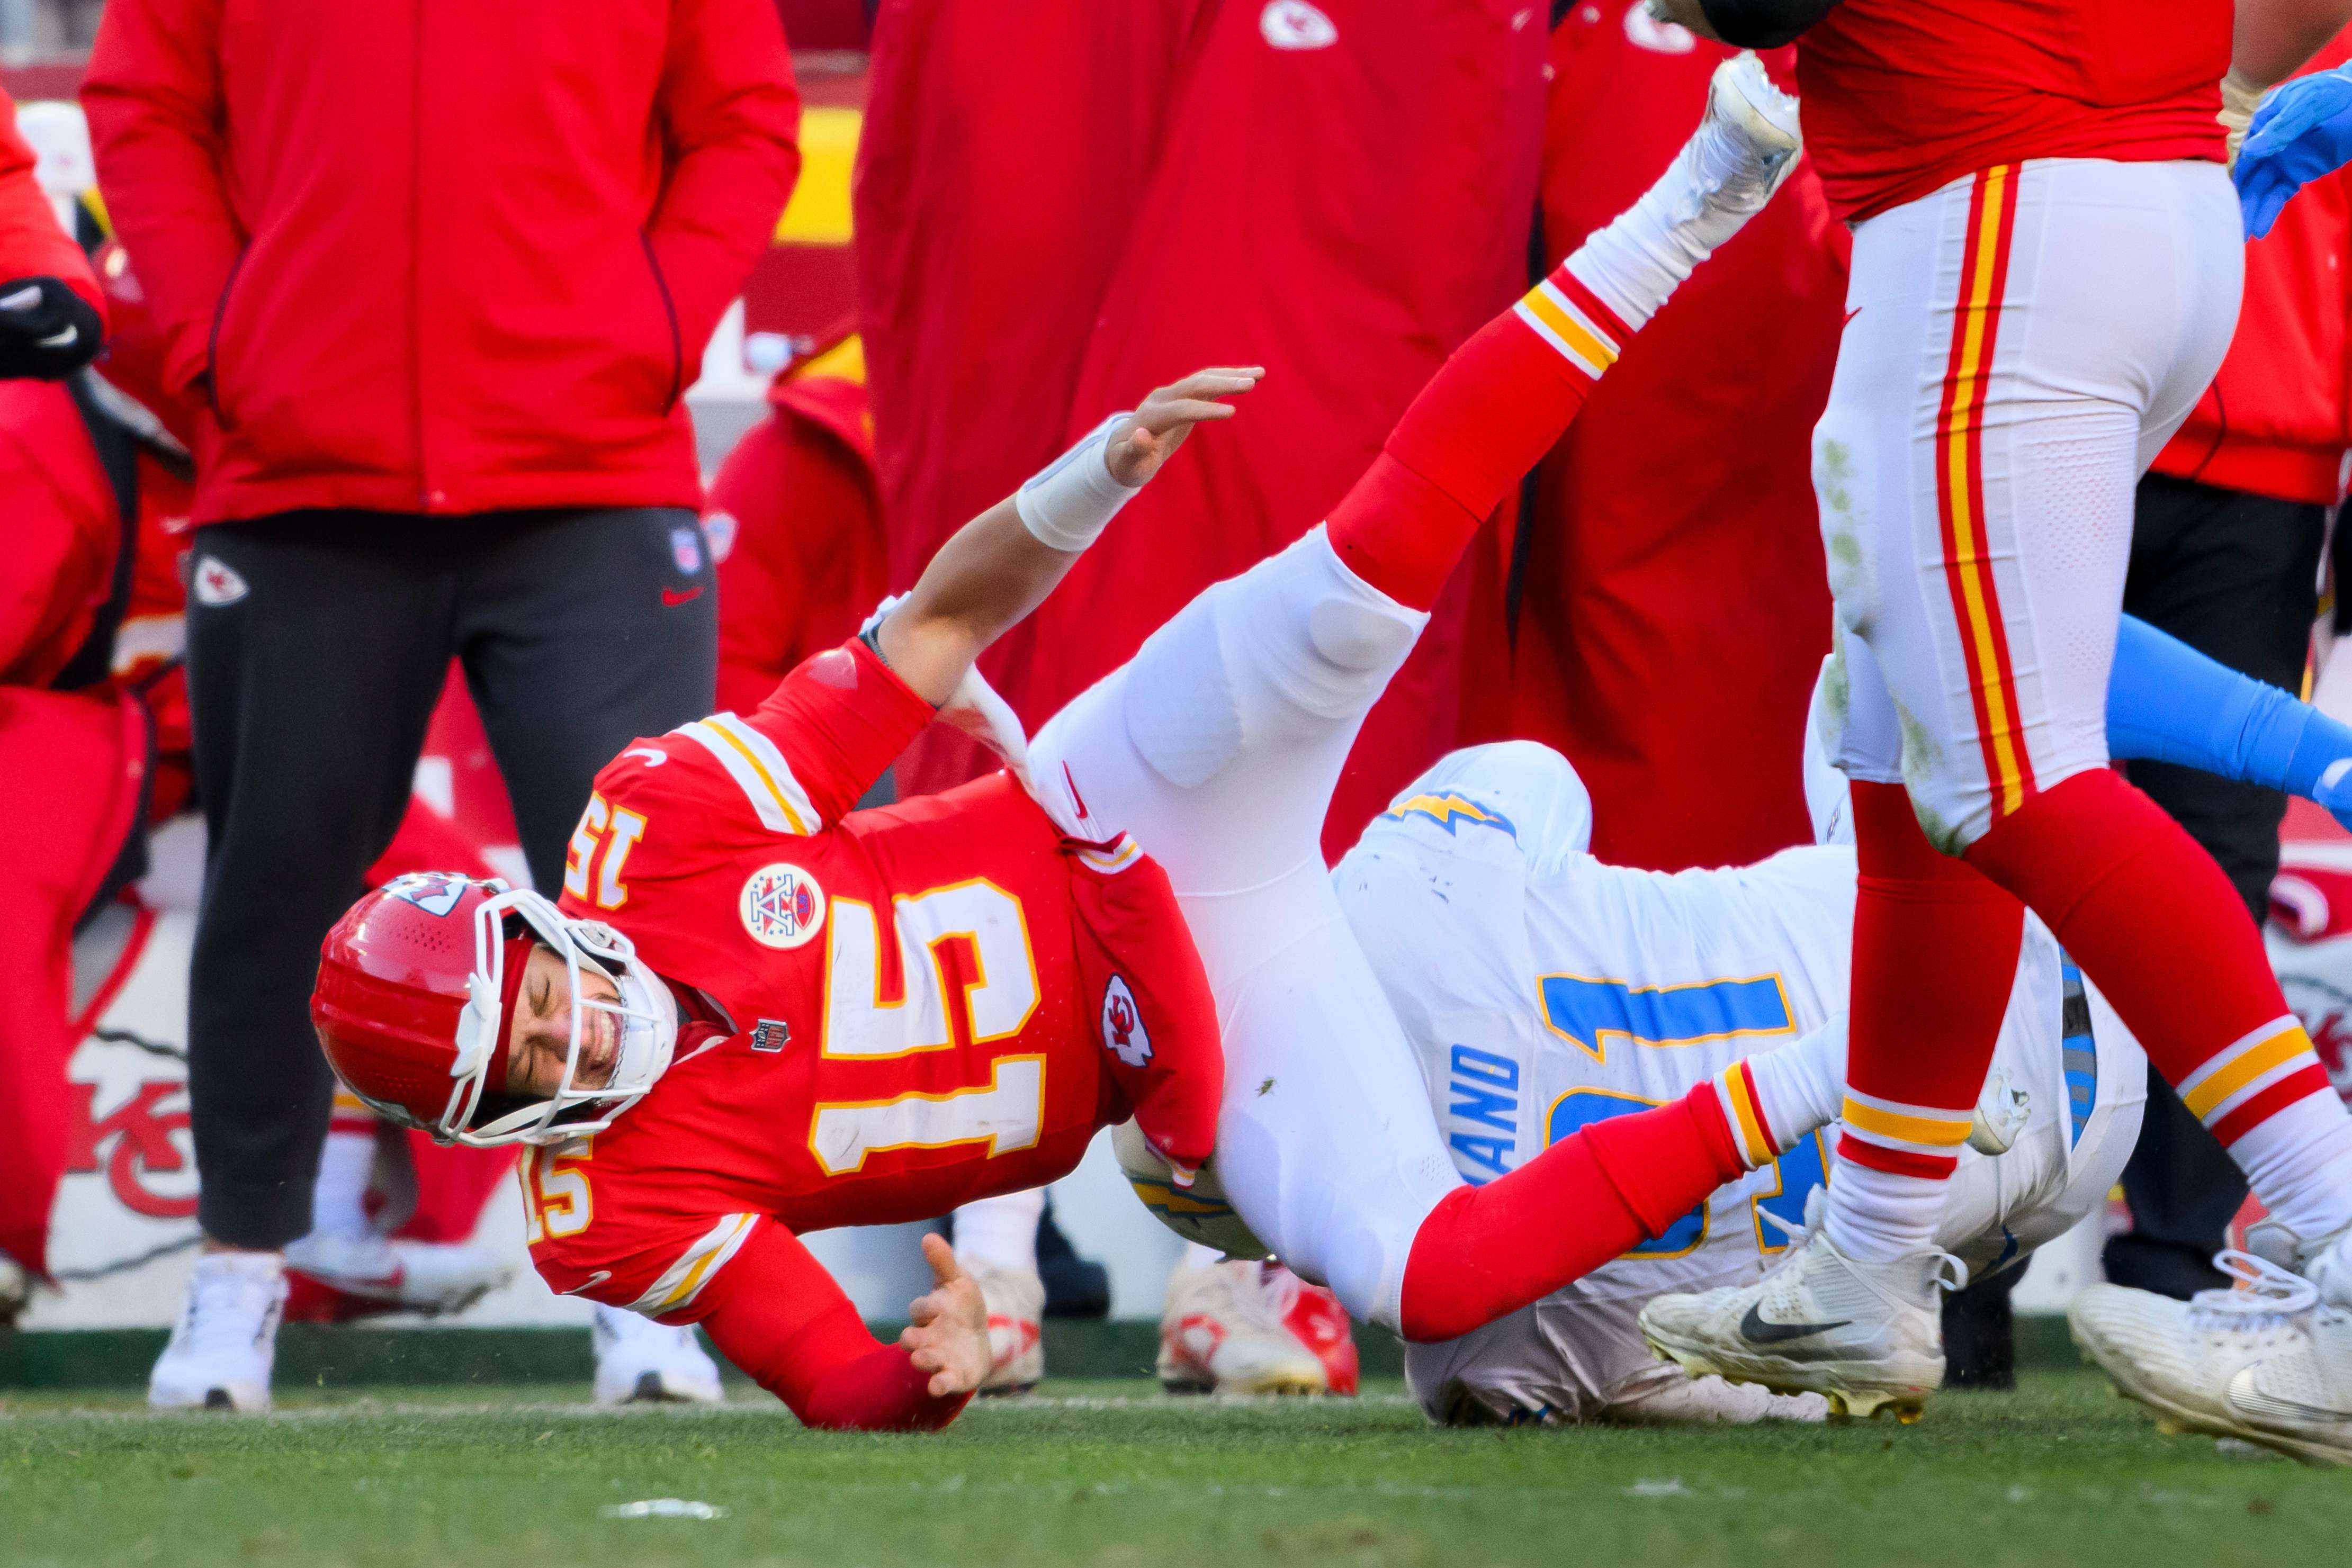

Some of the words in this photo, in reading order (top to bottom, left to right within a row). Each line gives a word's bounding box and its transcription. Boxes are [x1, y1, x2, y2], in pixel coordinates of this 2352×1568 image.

[564, 790, 648, 911] 15
[807, 876, 1046, 1177] 15
[1449, 1044, 1519, 1188] AND
[519, 1134, 593, 1246] 15
